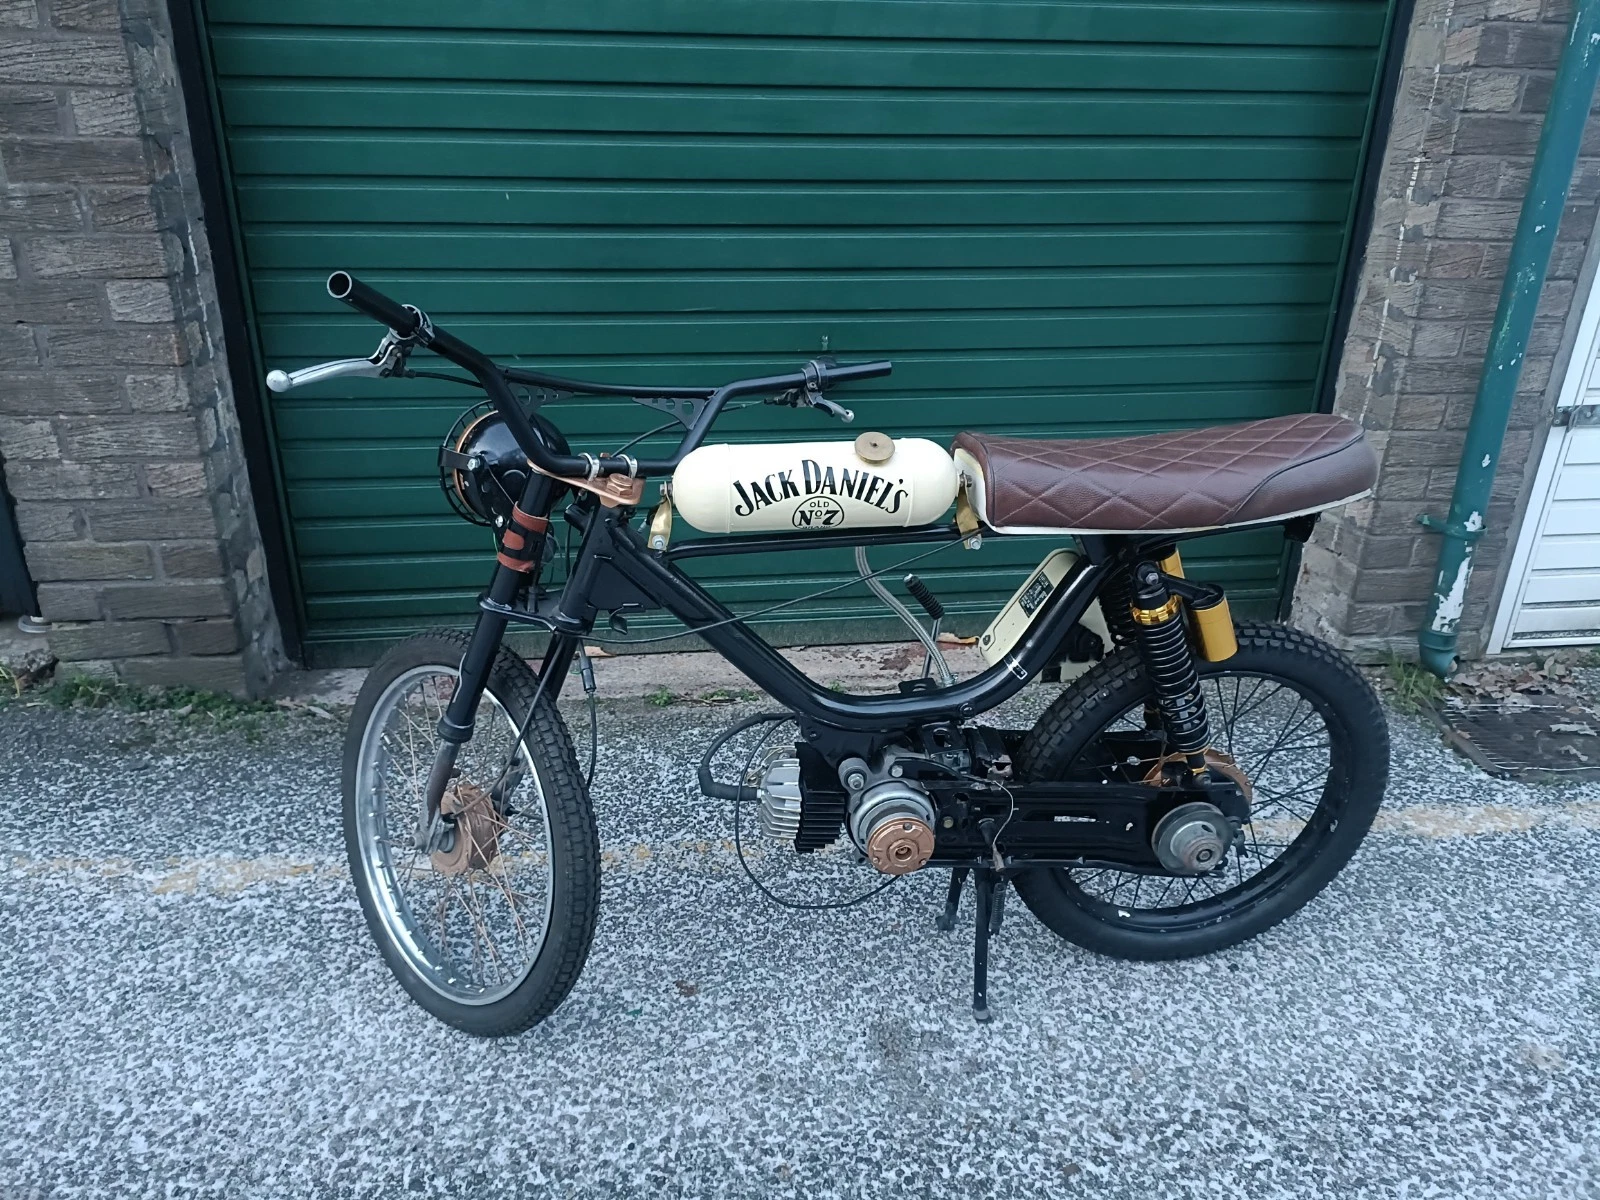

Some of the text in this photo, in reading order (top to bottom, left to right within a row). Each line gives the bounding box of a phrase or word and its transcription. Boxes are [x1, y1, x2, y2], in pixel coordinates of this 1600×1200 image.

[733, 459, 909, 516] JACK DANIEL'S
[809, 500, 830, 508] OLD
